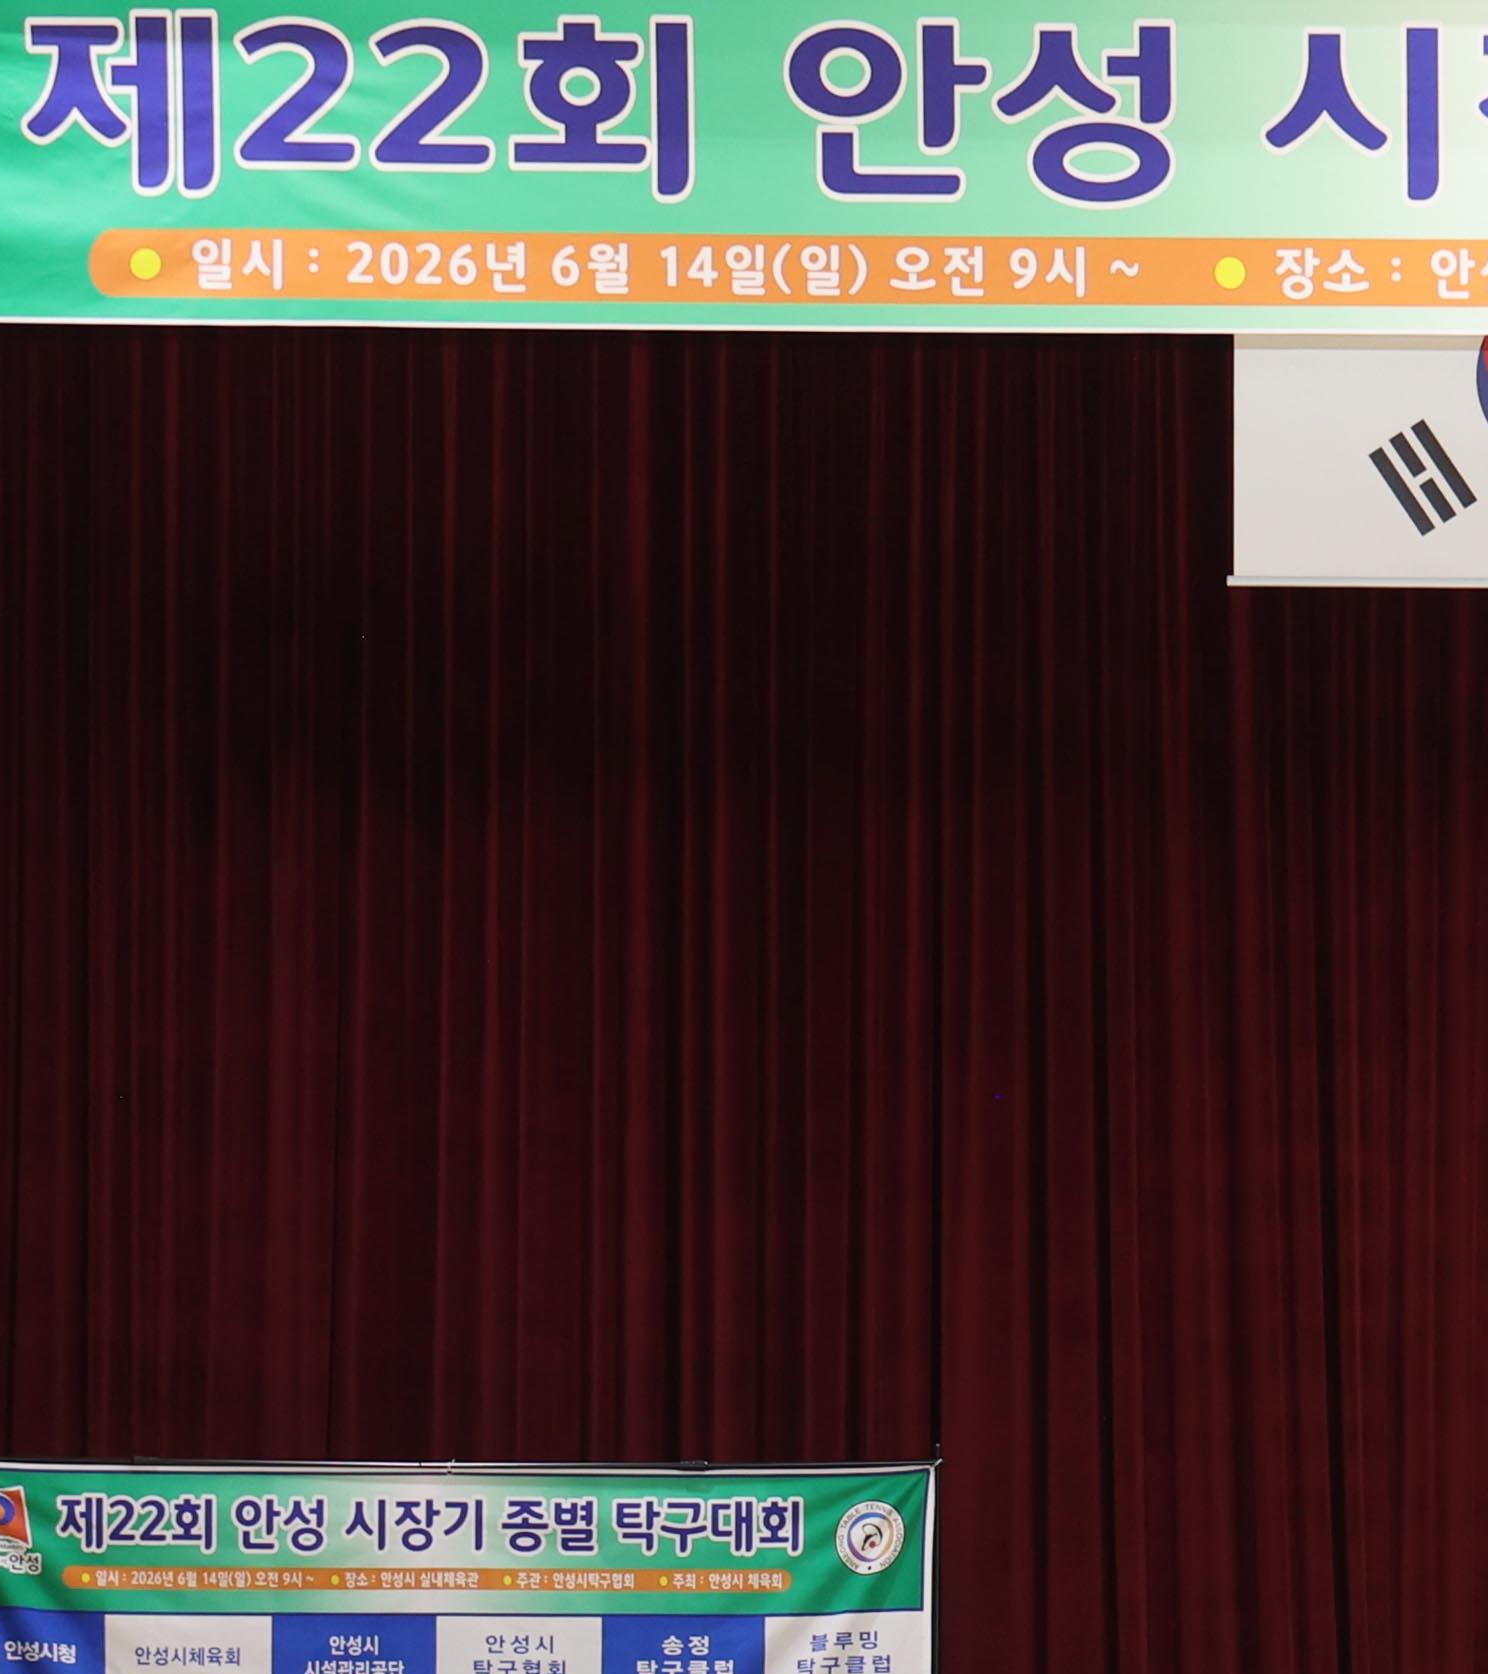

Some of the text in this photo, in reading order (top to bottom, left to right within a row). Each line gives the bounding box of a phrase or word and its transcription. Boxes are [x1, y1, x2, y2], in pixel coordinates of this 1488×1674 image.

[26, 14, 693, 196] 제22회
[786, 21, 1172, 203] 안성
[192, 238, 287, 286] 일시
[346, 240, 532, 290] 2026년
[551, 240, 631, 293] 6월
[658, 242, 868, 296] 14일(일)
[888, 246, 988, 296] 오전
[1009, 246, 1088, 297] 9시
[1275, 250, 1370, 298] 장소
[59, 1497, 212, 1550] 제22회
[234, 1497, 328, 1551] 안성
[345, 1499, 484, 1551] 시장기
[501, 1499, 598, 1552] 종별
[615, 1500, 802, 1553] 탁구대회
[95, 1570, 303, 1589] 일시 2026년 6월 14일(일) 오전 9시
[345, 1571, 480, 1589] 장소 안성시 실내체육관
[516, 1572, 635, 1590] 주관 안성시탁구협회
[672, 1571, 783, 1590] 주최 안성시 체육회
[329, 1635, 379, 1655] 안성시
[485, 1634, 555, 1655] 안성시
[661, 1634, 710, 1656] 송정
[809, 1630, 879, 1652] 블루밍
[3, 1640, 77, 1664] 안성시청
[134, 1646, 241, 1667] 안성시체육회
